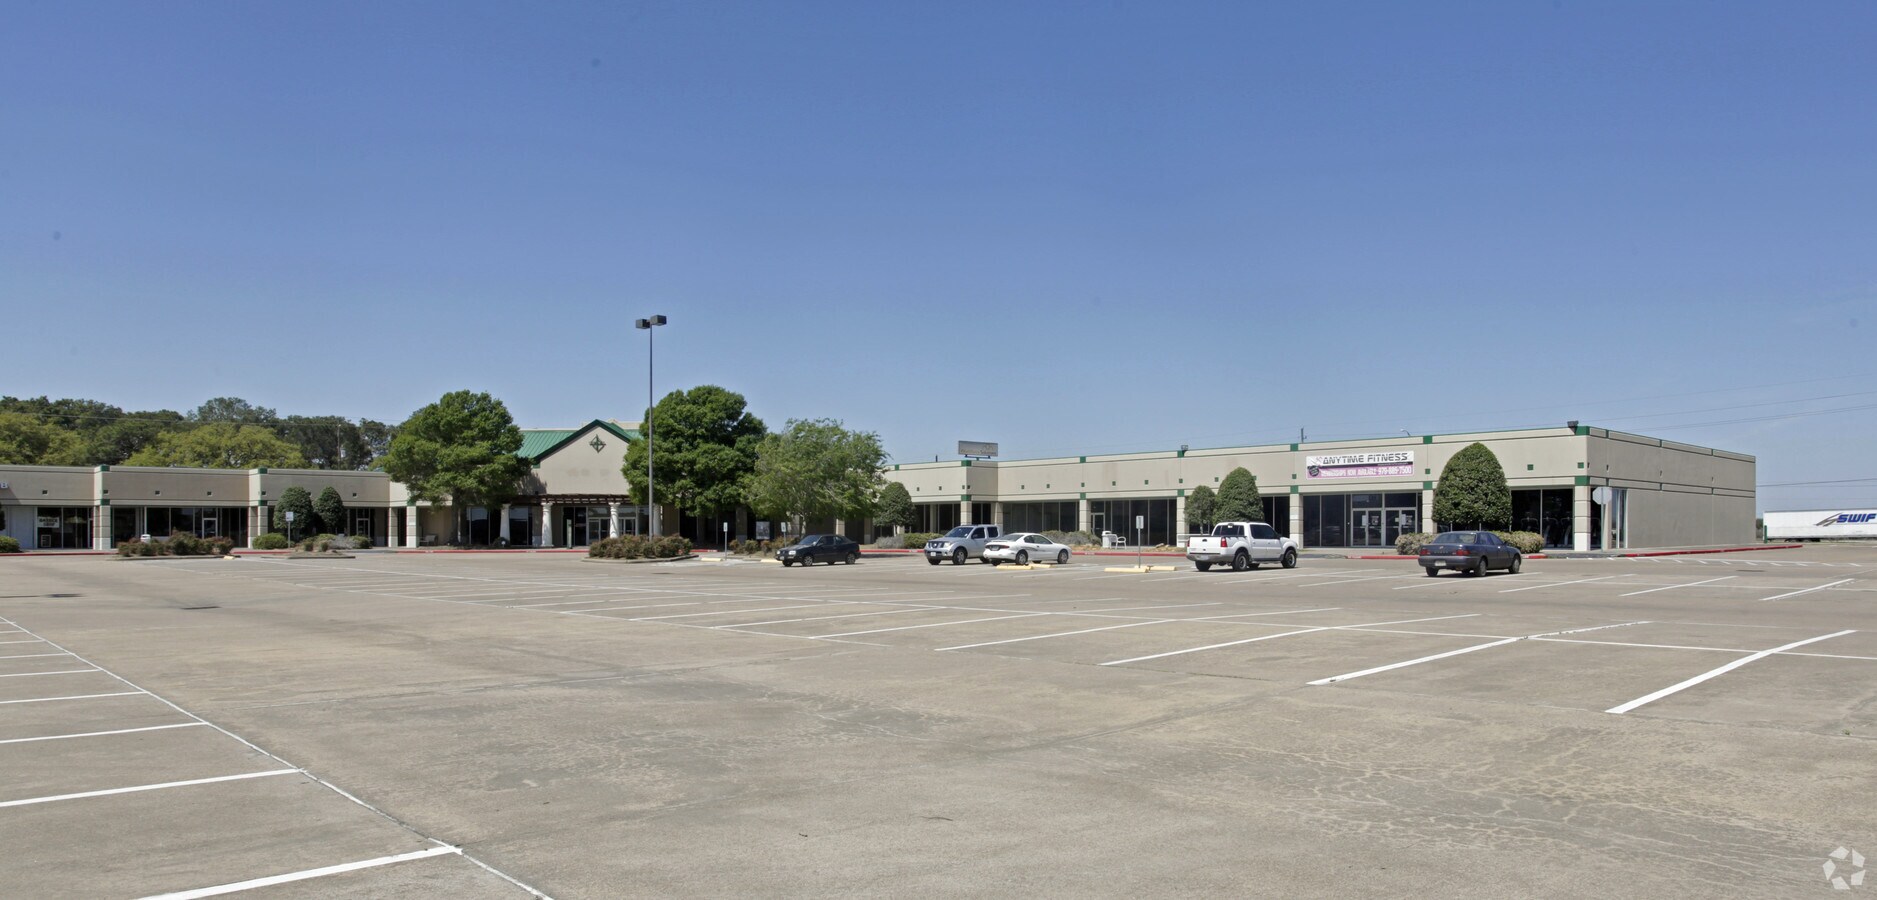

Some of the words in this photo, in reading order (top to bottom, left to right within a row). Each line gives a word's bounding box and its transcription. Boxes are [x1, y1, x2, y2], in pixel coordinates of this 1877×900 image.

[1322, 454, 1365, 465] ANYTIME
[1367, 452, 1408, 463] FITNESS
[1836, 513, 1877, 523] SWIF
